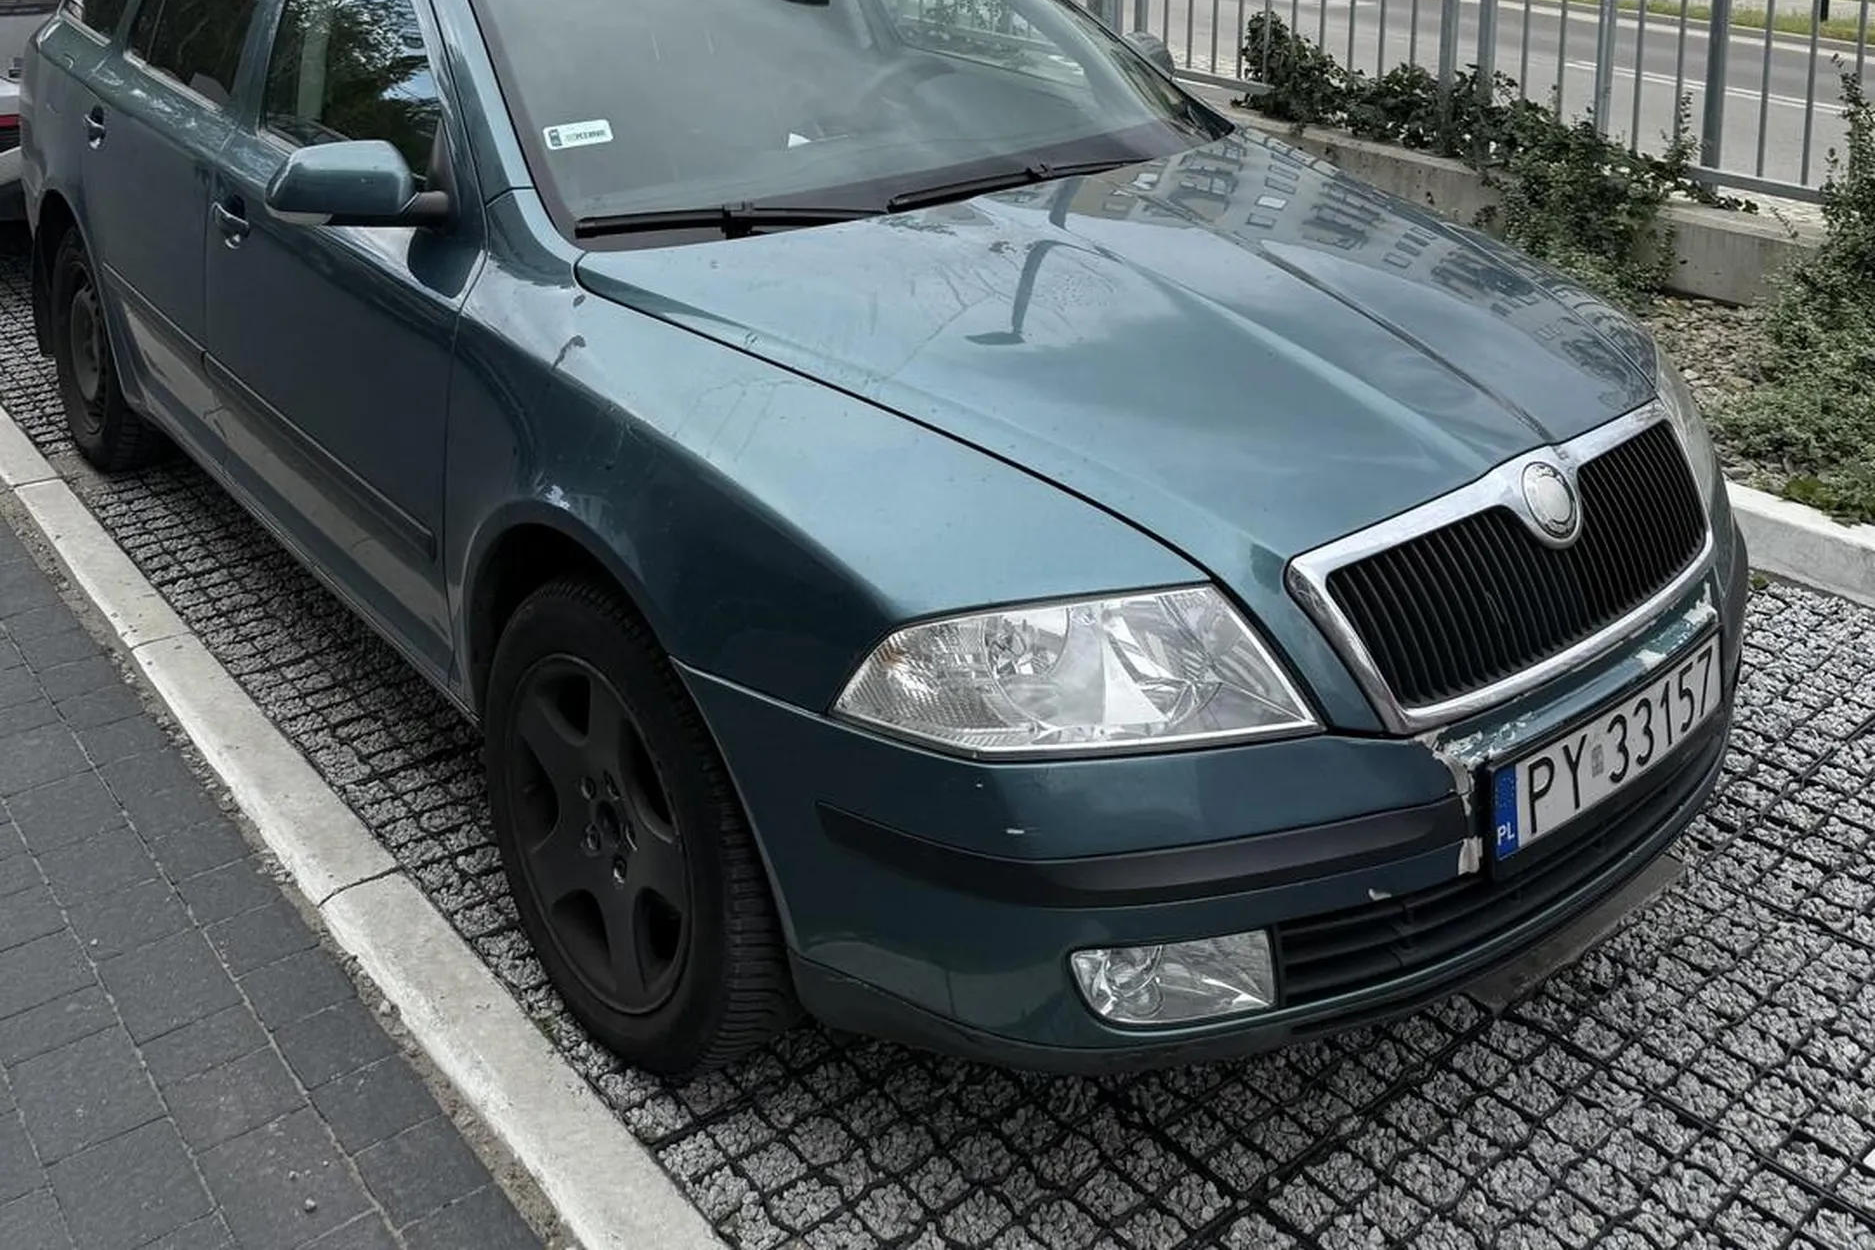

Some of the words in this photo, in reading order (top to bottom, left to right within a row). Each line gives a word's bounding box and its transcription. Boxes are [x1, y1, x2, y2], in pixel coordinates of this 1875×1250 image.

[1527, 733, 1588, 835] PY
[1607, 644, 1713, 784] 33157
[1496, 824, 1516, 846] PL
